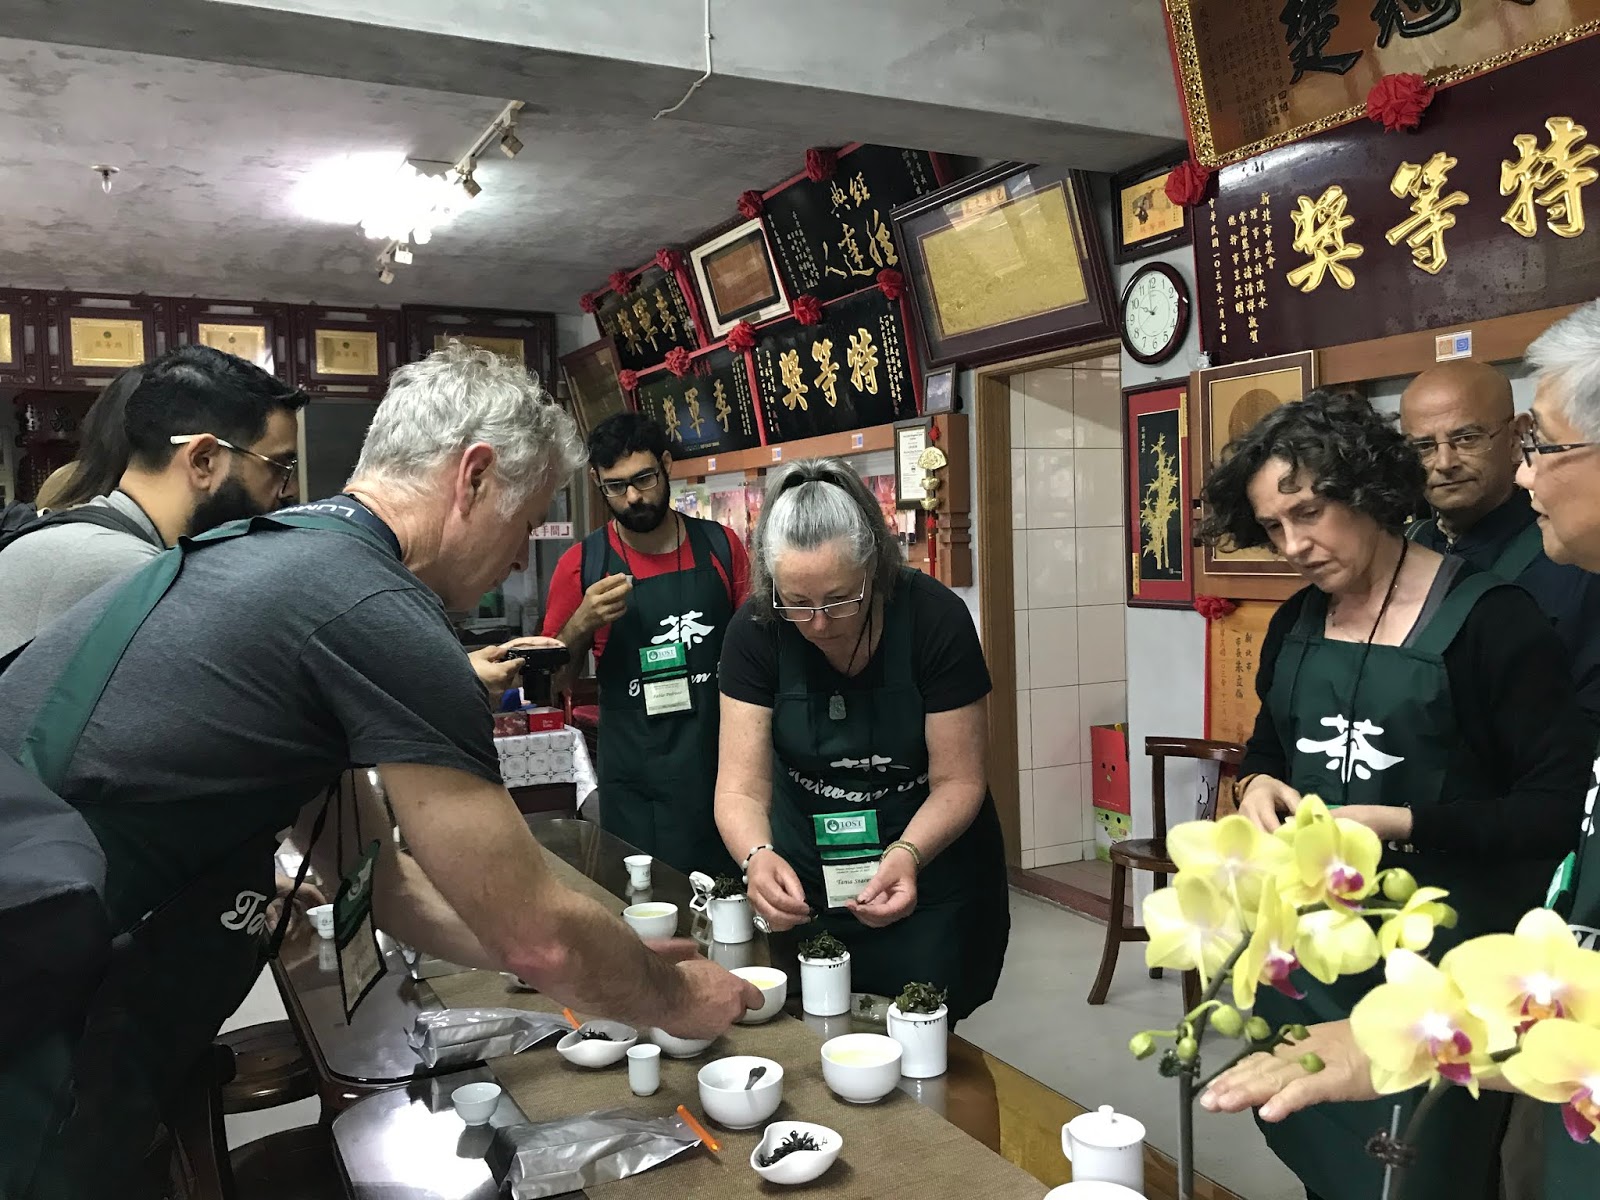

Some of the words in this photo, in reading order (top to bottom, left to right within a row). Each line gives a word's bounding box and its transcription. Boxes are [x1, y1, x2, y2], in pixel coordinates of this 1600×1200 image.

[1260, 191, 1276, 269] 新北市農會
[1286, 116, 1600, 293] 特等獎
[779, 328, 878, 411] 特等獎
[650, 610, 715, 650] 茶
[1296, 714, 1405, 784] 茶
